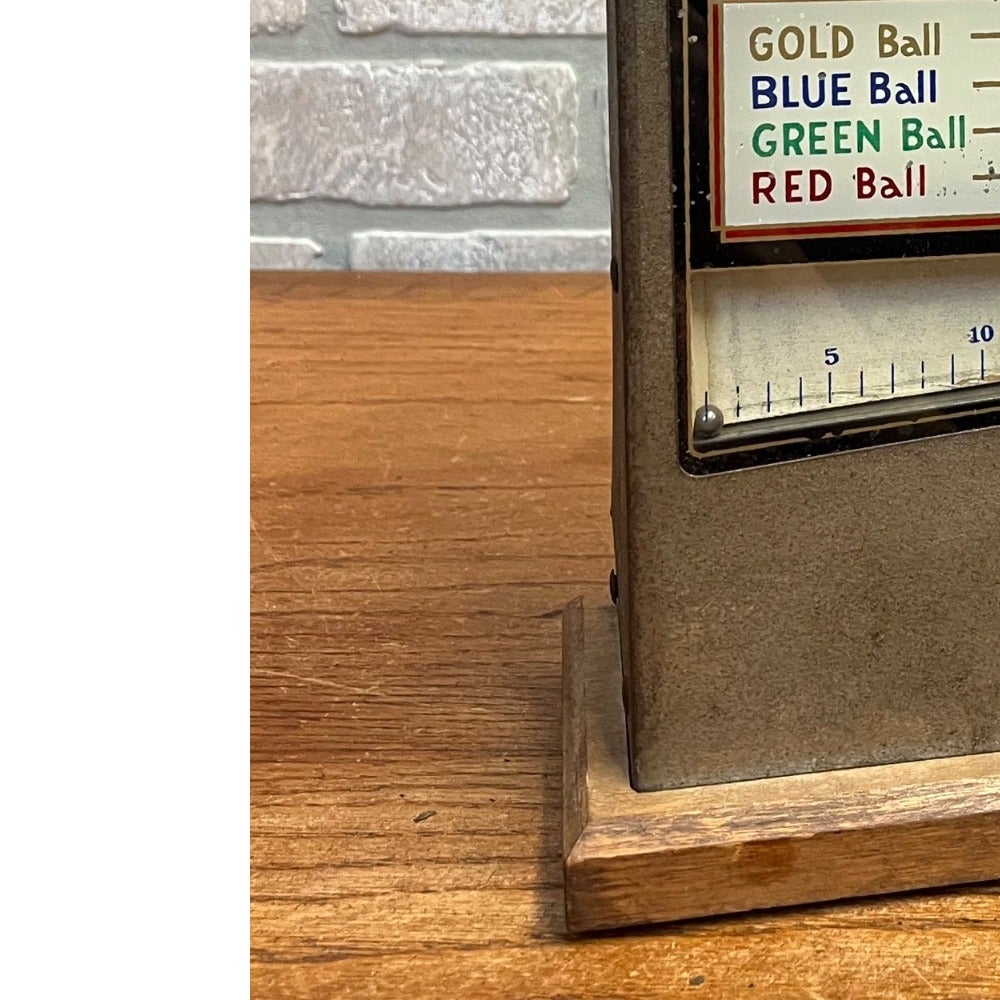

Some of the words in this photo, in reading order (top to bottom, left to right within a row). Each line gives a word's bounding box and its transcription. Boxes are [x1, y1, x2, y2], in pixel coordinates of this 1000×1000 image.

[750, 25, 853, 61] GOLD
[879, 23, 940, 58] Ball
[752, 72, 851, 109] BLUE
[871, 70, 936, 104] Ball
[752, 120, 880, 157] GREEN
[902, 115, 965, 151] Ball
[753, 170, 832, 204] RED
[857, 163, 925, 199] Ball
[968, 325, 995, 344] 10
[824, 348, 840, 366] 5
